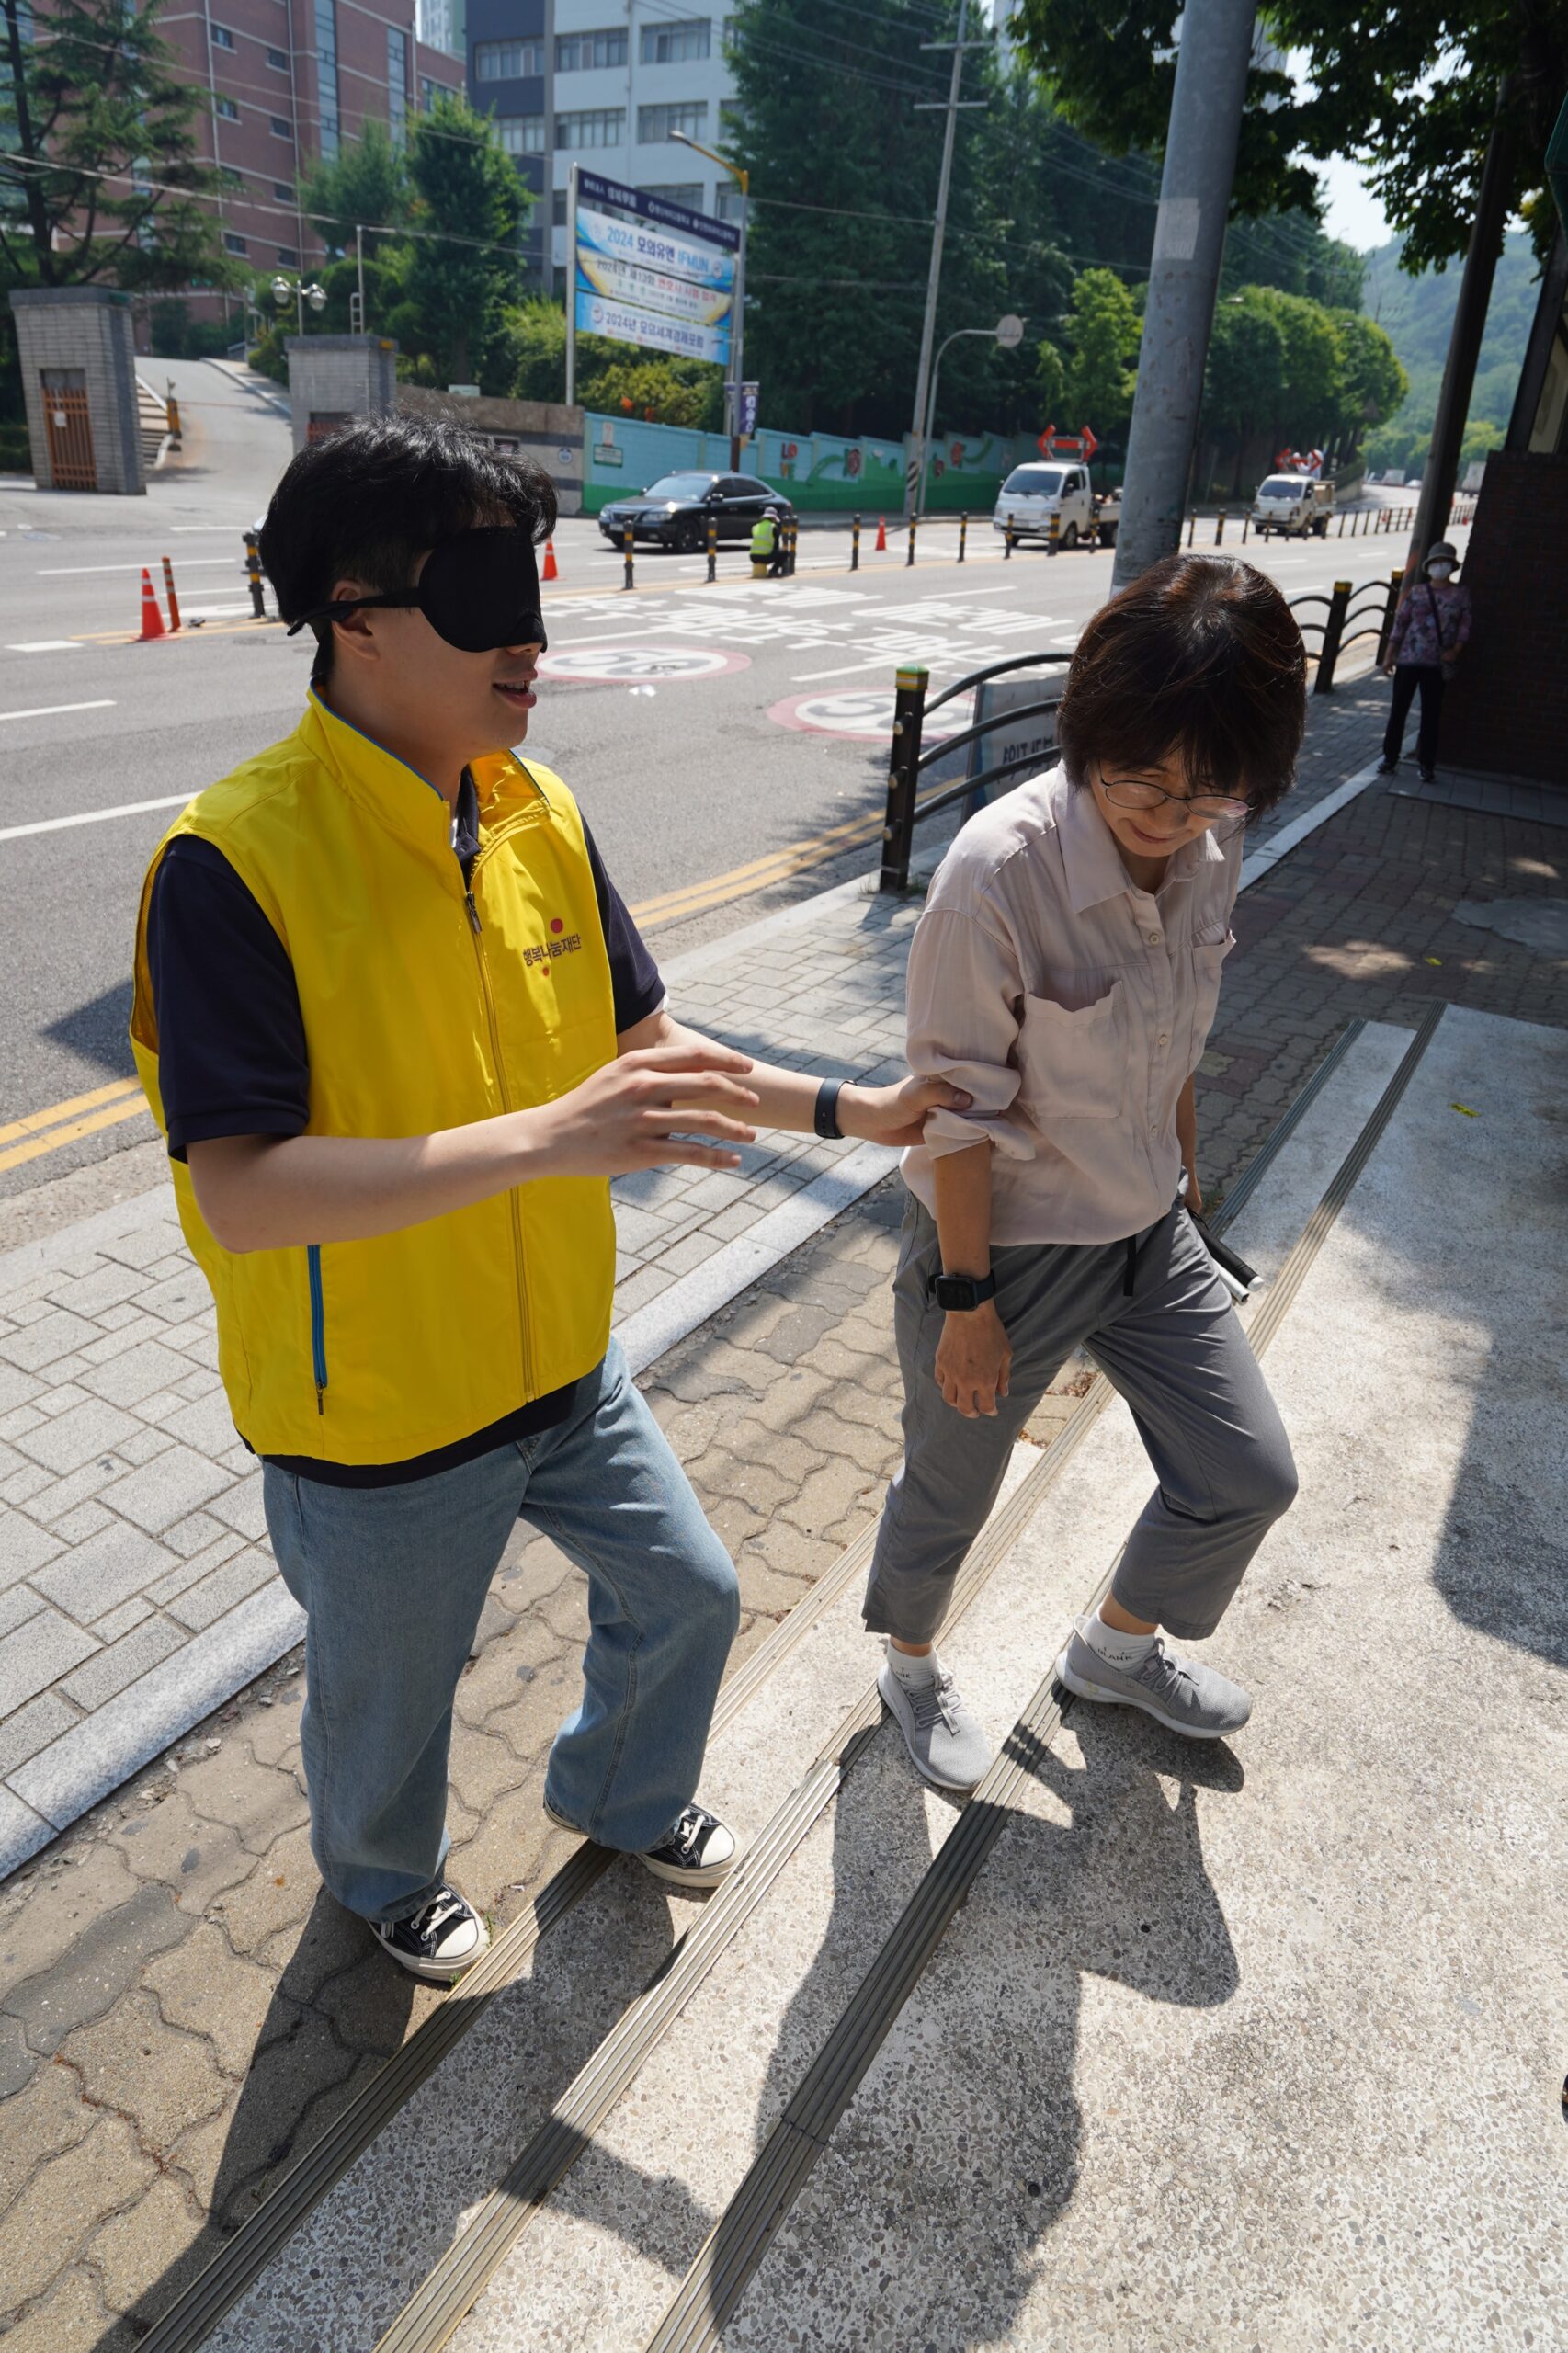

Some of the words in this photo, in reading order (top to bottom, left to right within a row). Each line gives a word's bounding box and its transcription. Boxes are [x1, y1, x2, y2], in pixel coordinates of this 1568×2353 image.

[608, 226, 633, 247] 2024
[638, 236, 675, 263] 모의유엔
[607, 311, 637, 332] 2024년
[522, 933, 582, 967] 행복나눔재단
